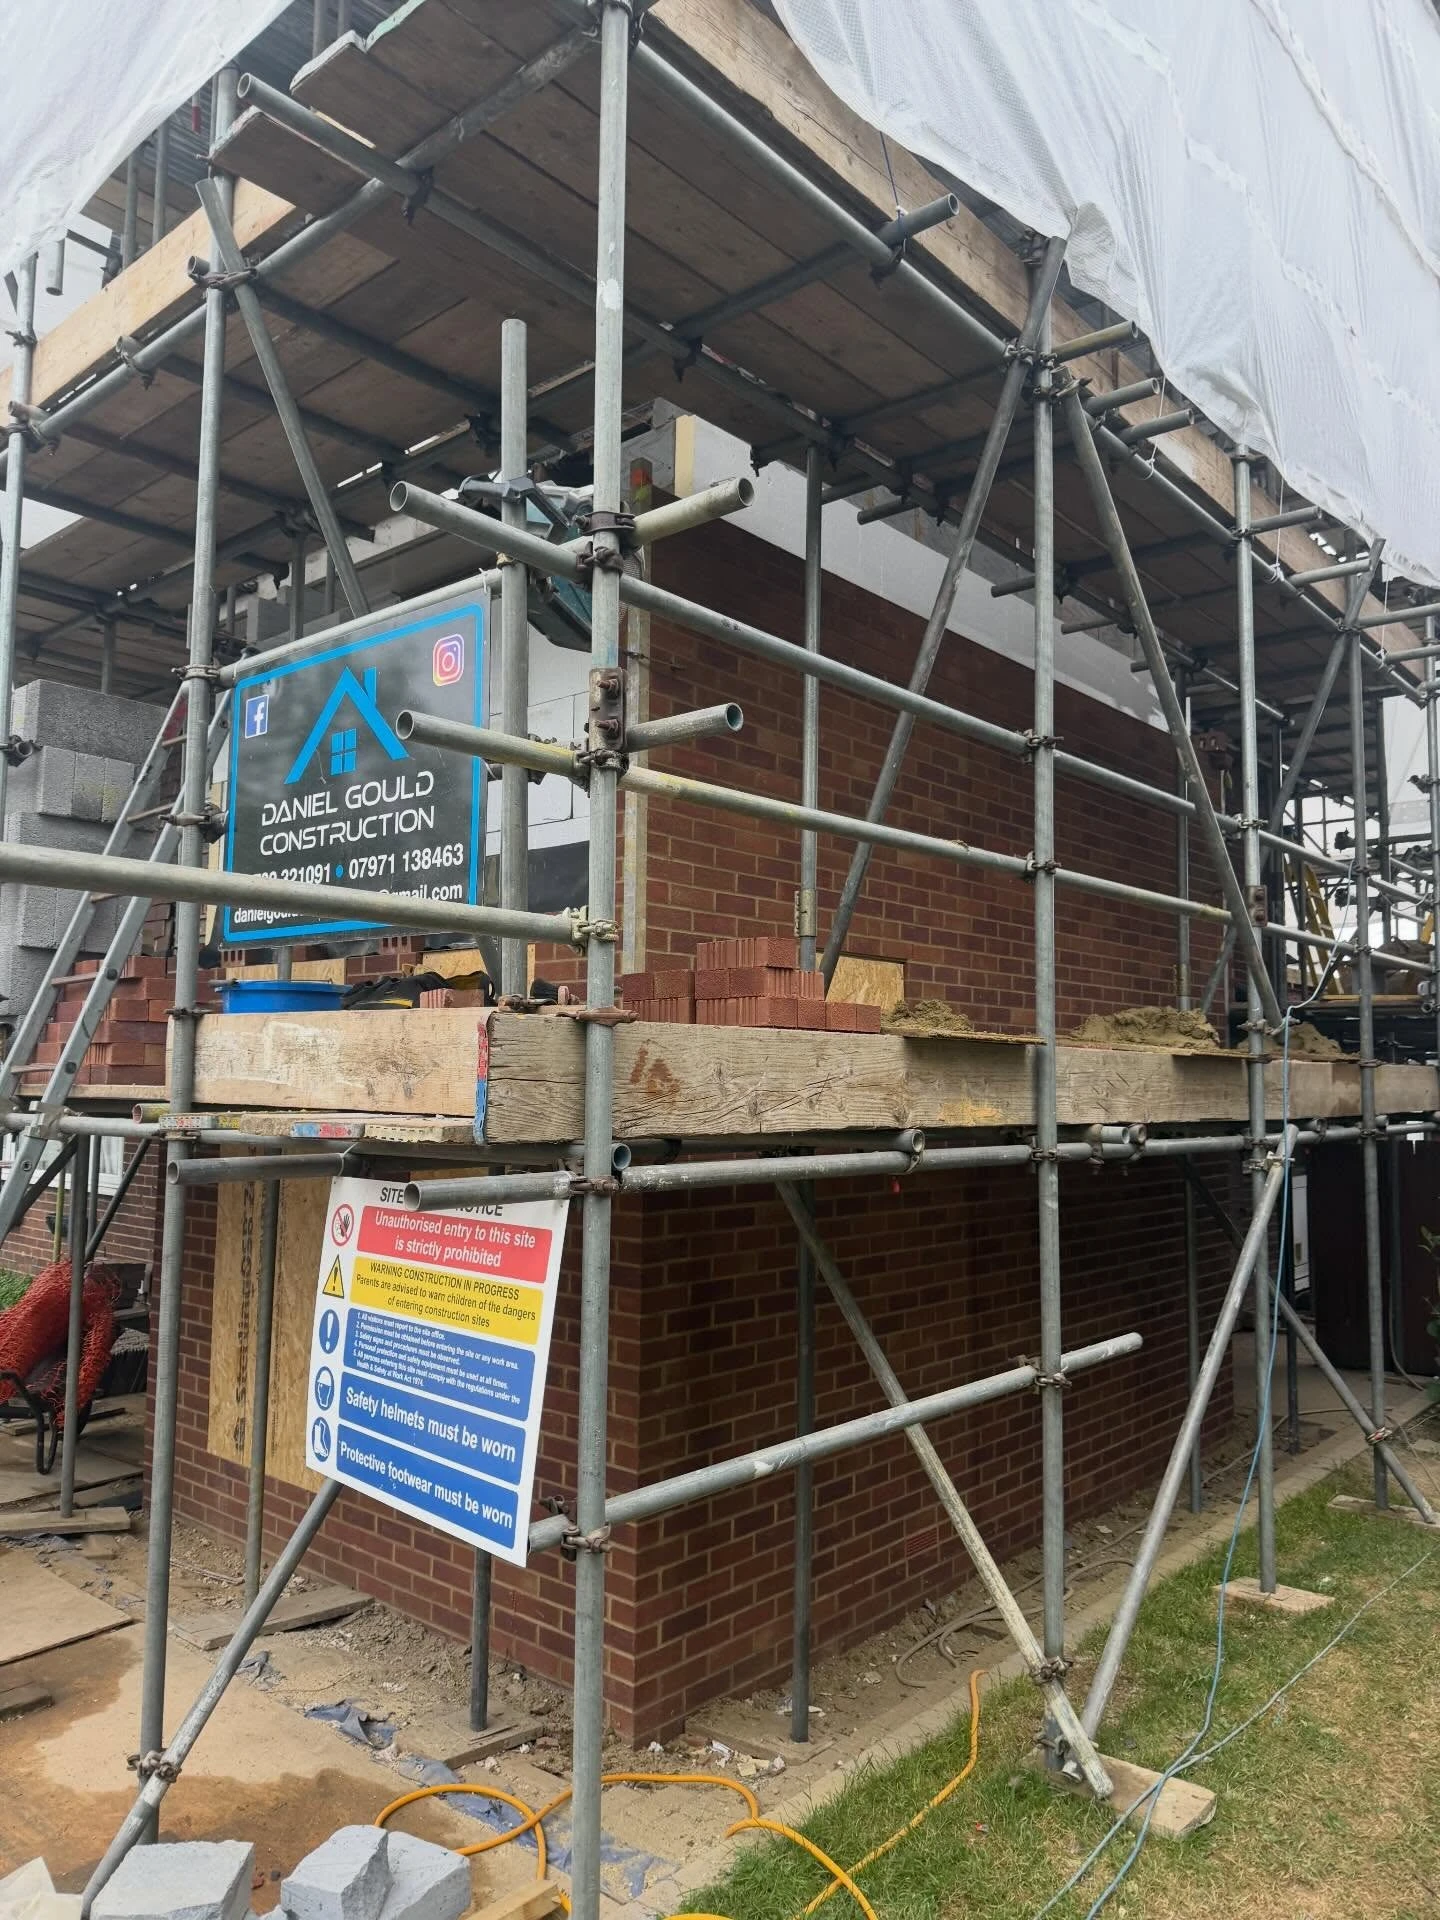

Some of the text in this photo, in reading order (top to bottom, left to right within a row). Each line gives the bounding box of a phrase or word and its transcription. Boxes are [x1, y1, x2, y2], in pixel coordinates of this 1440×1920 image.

[262, 770, 434, 826] DANIEL GOULD
[260, 805, 435, 856] CONSTRUCTION
[348, 853, 395, 880] 07971
[402, 842, 464, 872] 138463
[380, 1187, 404, 1204] SITE
[375, 1210, 536, 1248] Unauthorised entry to this site
[395, 1236, 501, 1268] is strictly prohibited
[356, 1274, 536, 1321] Parents are advised to warn children of the dangers
[370, 1262, 520, 1301] WARNING CONSTRUCTION IN PROGRESS
[388, 1296, 490, 1328] of entering construction sites
[346, 1386, 516, 1463] Safety helmets must be worn
[340, 1441, 513, 1529] Protective footwear must be worn
